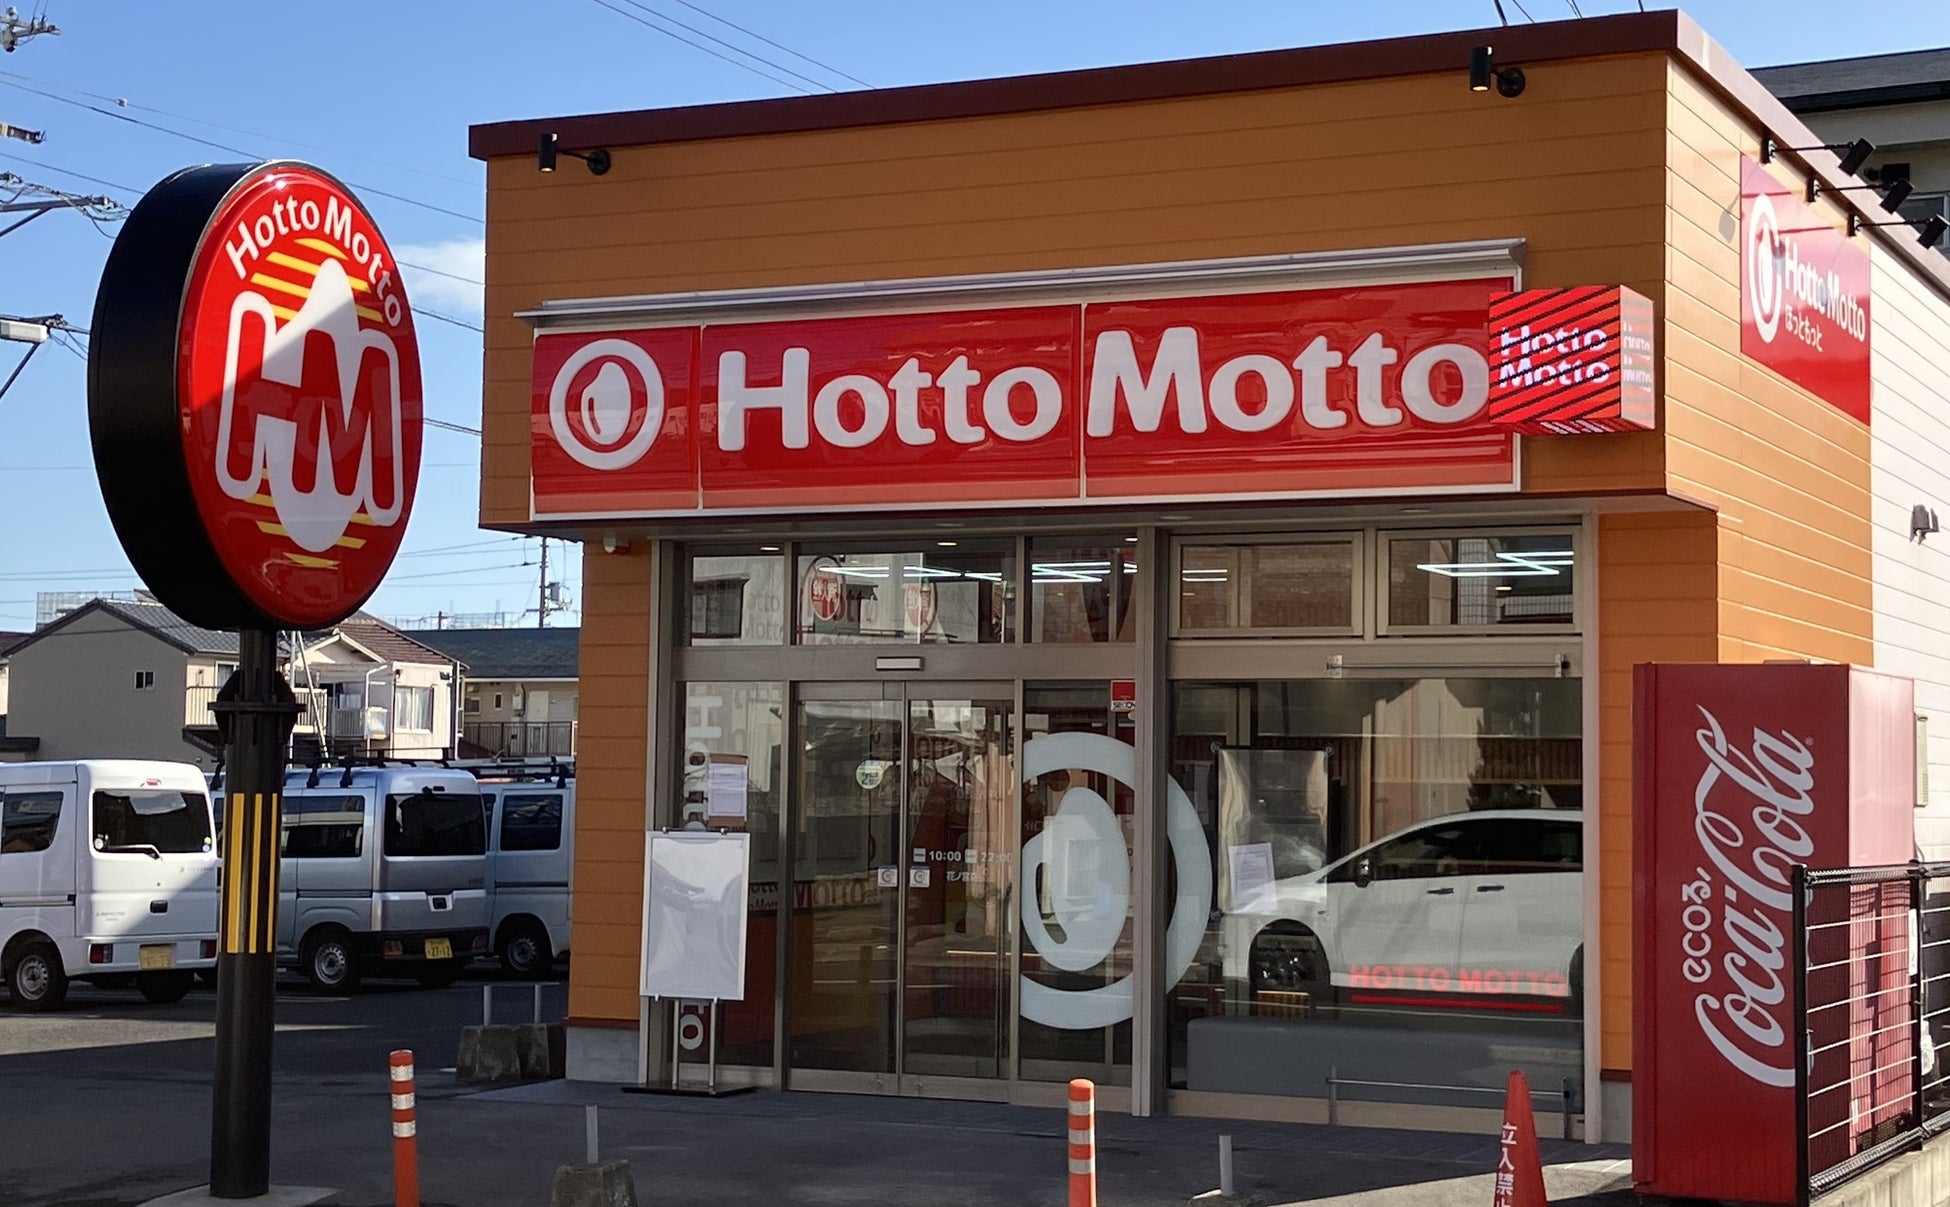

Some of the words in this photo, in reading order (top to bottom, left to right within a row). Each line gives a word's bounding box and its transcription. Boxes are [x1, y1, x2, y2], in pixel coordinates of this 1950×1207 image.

[225, 194, 320, 280] Hotto
[323, 195, 402, 327] Motto
[1784, 236, 1826, 314] Hotto
[1826, 269, 1866, 343] Motto
[1785, 302, 1824, 352] ほっともっと
[717, 347, 1063, 451] Hotto
[1087, 326, 1490, 438] Motto
[929, 851, 961, 861] 10:00
[1695, 704, 1814, 1088] Coca-Cola
[1350, 964, 1449, 991] HOTTO
[1458, 967, 1567, 997] MOTTO
